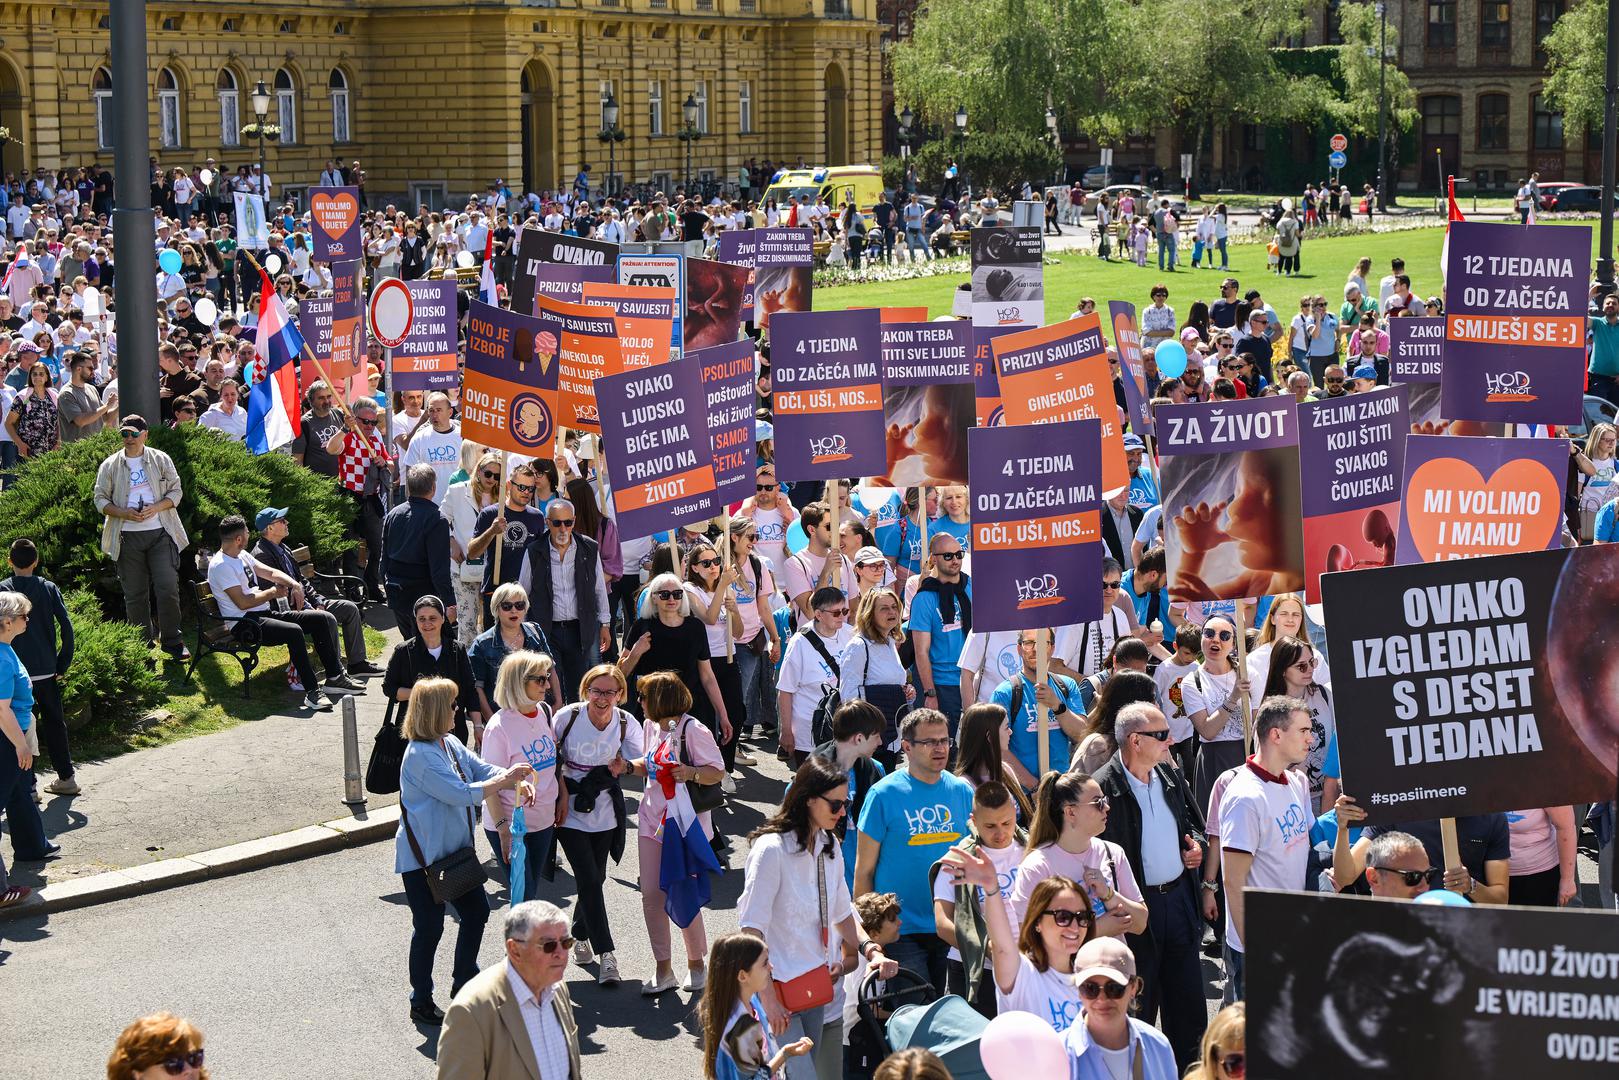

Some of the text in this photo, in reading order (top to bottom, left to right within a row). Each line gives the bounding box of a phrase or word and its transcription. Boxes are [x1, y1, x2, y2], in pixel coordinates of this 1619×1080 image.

[316, 202, 351, 210] MI VOLIMO
[325, 211, 347, 220] MAMU
[325, 221, 348, 229] DIJETE
[766, 233, 806, 241] ZAKON TREBA
[783, 243, 794, 252] SVE
[794, 243, 811, 252] LJUDE
[552, 243, 605, 266] OVAKO
[737, 242, 756, 255] ŽIVO
[757, 254, 771, 263] BEZ
[1463, 255, 1574, 278] 12 TJEDANA
[411, 288, 441, 300] SVAKO
[539, 281, 570, 294] PRIZIV
[1463, 285, 1570, 310] OD ZAČEĆA
[308, 302, 333, 314] ŽELIM
[412, 305, 446, 318] UDSKO
[623, 302, 670, 315] SAVIJESTI
[315, 316, 333, 327] KOJI
[429, 323, 446, 335] IMA
[471, 318, 510, 343] OVO JE
[567, 319, 613, 333] SAVIJESTI
[1453, 317, 1577, 345] SMIJEŠI SE :)
[320, 330, 333, 340] SVA
[333, 336, 345, 348] OVO
[620, 337, 654, 349] KOLOG
[796, 337, 858, 354] 4 TJEDNA
[916, 329, 954, 342] TREBA
[317, 342, 332, 354] ČOV
[403, 341, 449, 354] PRAVO NA
[470, 336, 505, 359] IZBOR
[907, 346, 966, 360] SVE LJUDE
[974, 344, 989, 358] JE
[1002, 350, 1043, 372] PRIZIV
[1046, 335, 1100, 362] SAVIJESTI
[1398, 340, 1441, 356] ŠTITITI
[413, 357, 441, 371] ŽIVOT
[559, 365, 576, 376] KOJI
[776, 361, 877, 383] OD ZAČEĆA IMA
[887, 363, 970, 378] DISKIMINACIJE
[1396, 362, 1419, 375] BEZ
[560, 380, 572, 392] NE
[625, 373, 674, 399] SVAKO
[1485, 371, 1530, 388] HOD
[1487, 386, 1501, 395] ZA
[466, 388, 506, 413] OVO JE
[707, 379, 753, 408] poštovati
[779, 389, 877, 411] OČI, UŠI, NOS...
[1028, 383, 1094, 412] GINEKOLOG
[465, 405, 506, 430] DIJETE
[622, 398, 685, 428] LJUDSKO
[731, 403, 753, 423] život
[1312, 395, 1400, 428] ŽELIM ZAKON
[716, 426, 748, 450] SAMOG
[1167, 409, 1288, 445] ZA ŽIVOT
[1327, 423, 1392, 452] KOJI ŠTITI
[626, 430, 659, 454] BIĆE
[662, 424, 690, 446] IMA
[809, 434, 846, 451] HOD
[428, 445, 456, 459] HOD
[1335, 449, 1388, 476] SVAKOG
[626, 449, 697, 481] PRAVO NA
[1002, 454, 1074, 476] 4 TJEDNA
[645, 478, 686, 504] ŽIVOT
[978, 484, 1096, 511] OD ZAČEĆA IMA
[1331, 473, 1394, 501] ČOVJEKA!
[670, 498, 711, 517] -Ustav RH
[1423, 489, 1541, 515] MI VOLIMO
[980, 523, 1012, 545] OČI,
[1017, 520, 1048, 542] UŠI,
[1051, 519, 1095, 539] NOS...
[1438, 521, 1522, 546] I MAMU
[1015, 573, 1058, 596] HOD
[1018, 592, 1031, 602] ZA
[1402, 577, 1526, 628] OVAKO
[1352, 622, 1532, 679] IZGLEDAM
[1392, 667, 1535, 720] S DESET
[522, 734, 554, 760] HOD
[1385, 713, 1543, 767] TJEDANA
[1371, 785, 1467, 806] #spasiimene
[904, 804, 952, 828] HOD
[1497, 944, 1619, 980] MOJ ŽIVOT
[1475, 987, 1619, 1021] JE VRIJEDAN
[1547, 1032, 1619, 1063] OVDJE
